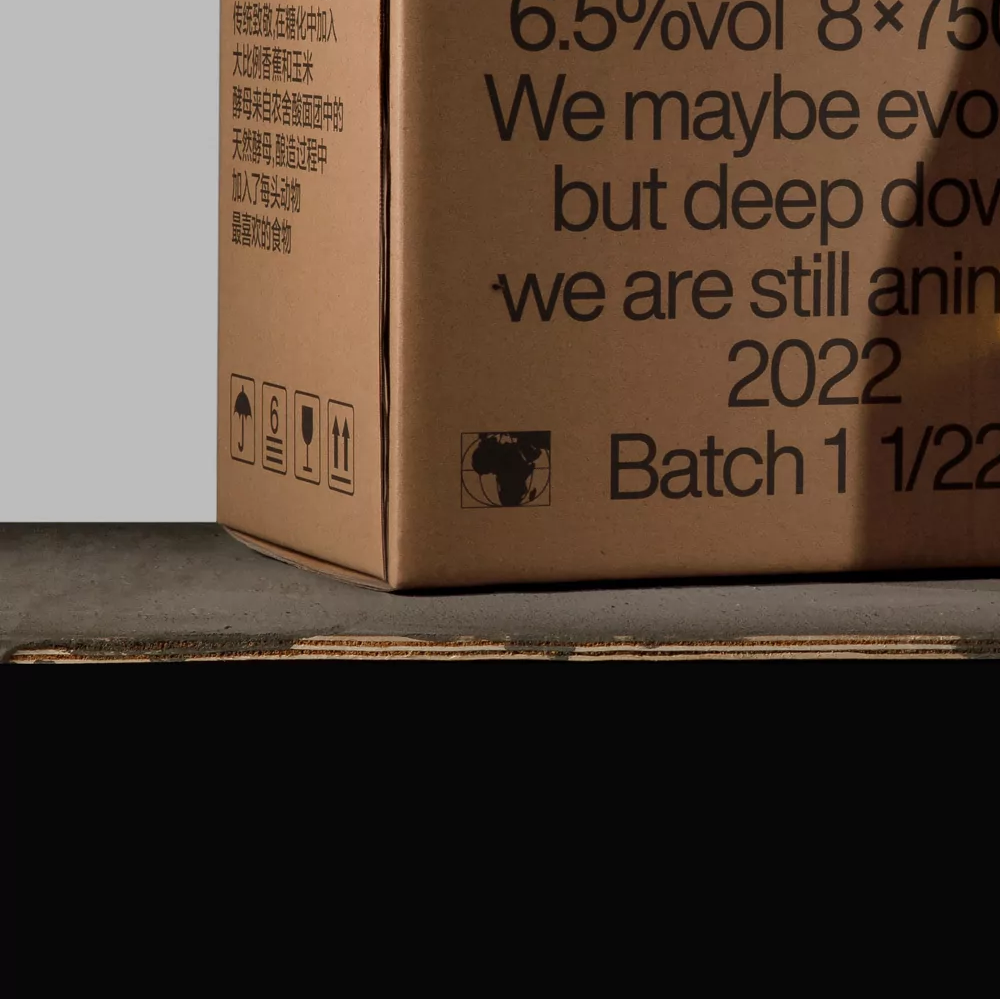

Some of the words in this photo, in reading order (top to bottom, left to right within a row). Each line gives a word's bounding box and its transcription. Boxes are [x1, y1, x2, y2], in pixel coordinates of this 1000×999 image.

[232, 42, 314, 85] 大比例香蕉和玉米
[484, 74, 605, 142] We
[625, 73, 860, 158] maybe
[232, 168, 302, 213] 加入了每头动物
[554, 164, 667, 232] but
[684, 163, 864, 246] deep
[231, 210, 292, 254] 最喜欢的食物
[500, 271, 605, 322] we
[623, 270, 733, 321] are
[750, 251, 849, 319] still
[728, 338, 901, 408] 2022
[270, 396, 279, 434] 6
[610, 429, 803, 500] Batch
